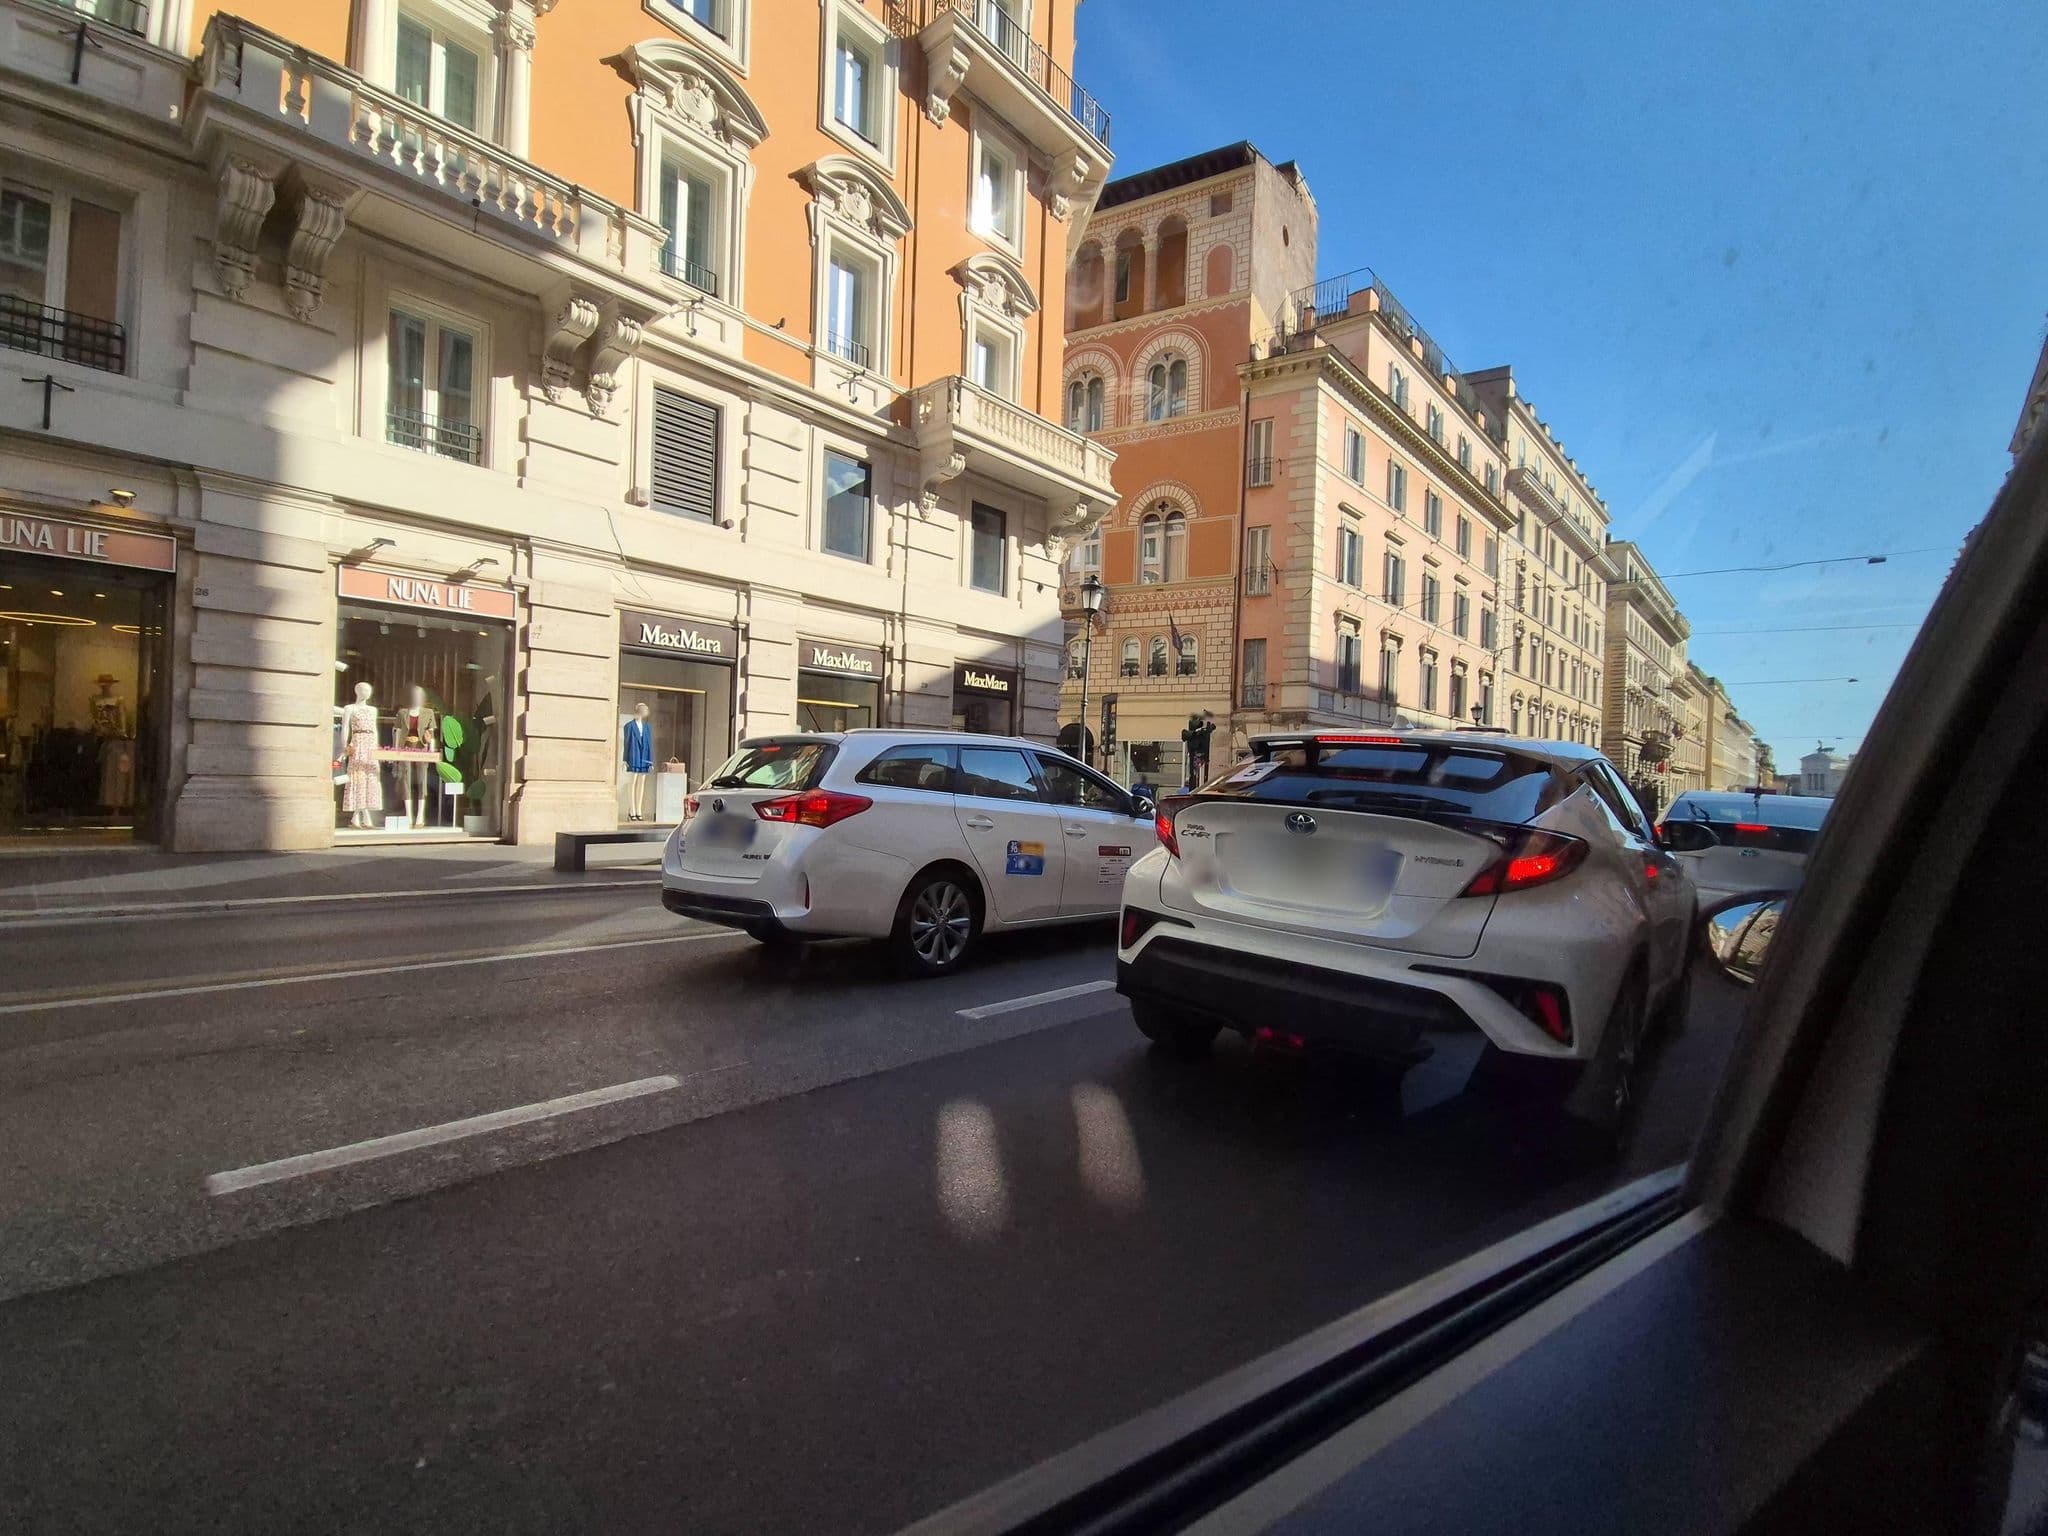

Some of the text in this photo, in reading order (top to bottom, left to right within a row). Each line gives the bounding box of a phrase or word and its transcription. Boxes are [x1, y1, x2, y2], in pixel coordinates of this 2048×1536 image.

[67, 528, 109, 558] LIE
[387, 577, 475, 610] NUNA LIE
[640, 623, 721, 653] MaxMara
[812, 647, 873, 672] MaxMara
[964, 670, 1008, 692] MaxMara
